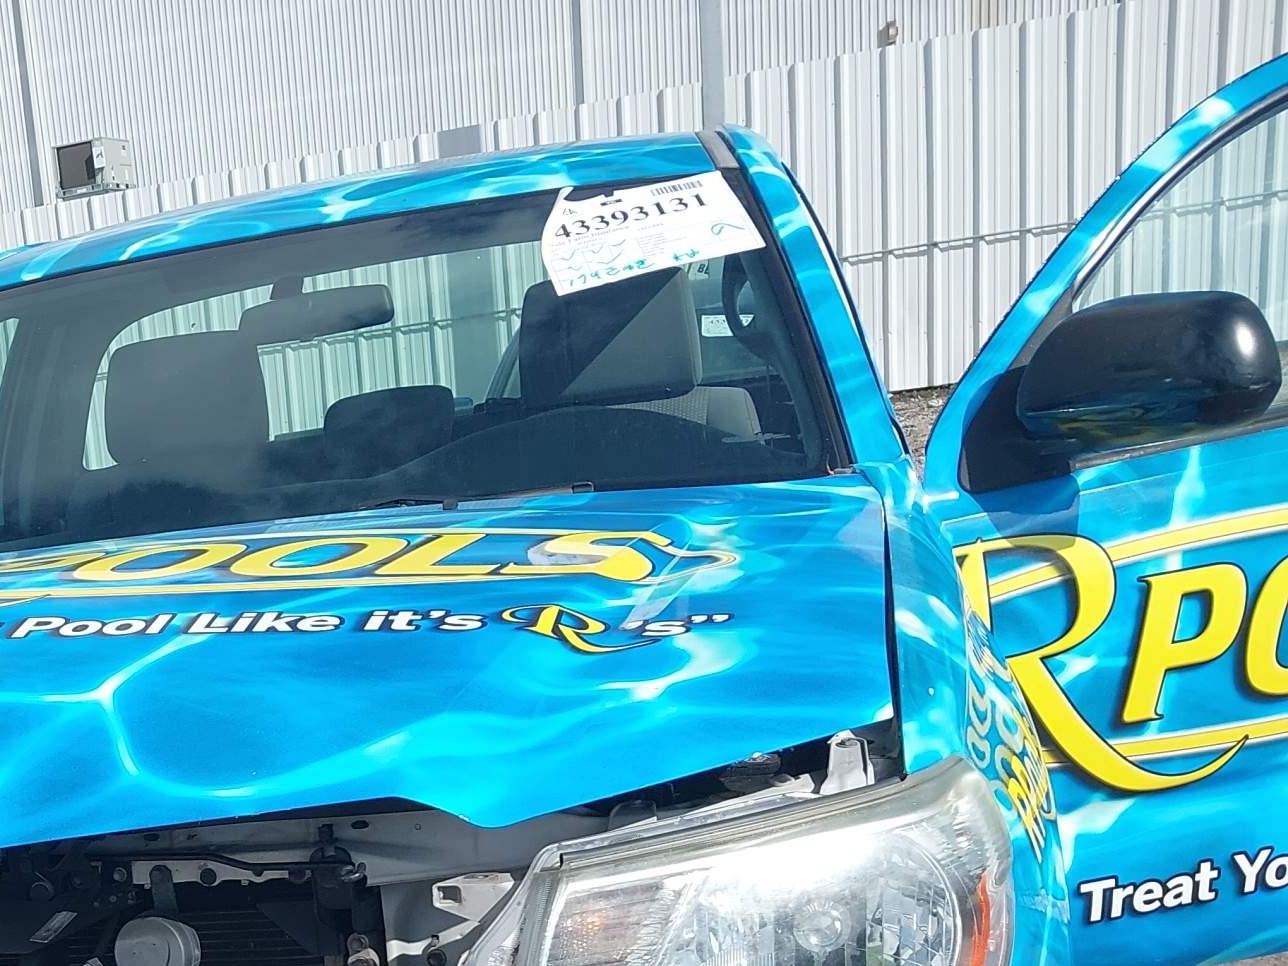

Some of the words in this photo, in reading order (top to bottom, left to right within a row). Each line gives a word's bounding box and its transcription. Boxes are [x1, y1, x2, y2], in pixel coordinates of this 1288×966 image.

[554, 193, 707, 238] 43393131
[9, 614, 175, 639] Pool
[187, 611, 342, 634] Like
[363, 609, 486, 632] it's
[1078, 859, 1219, 924] Treat
